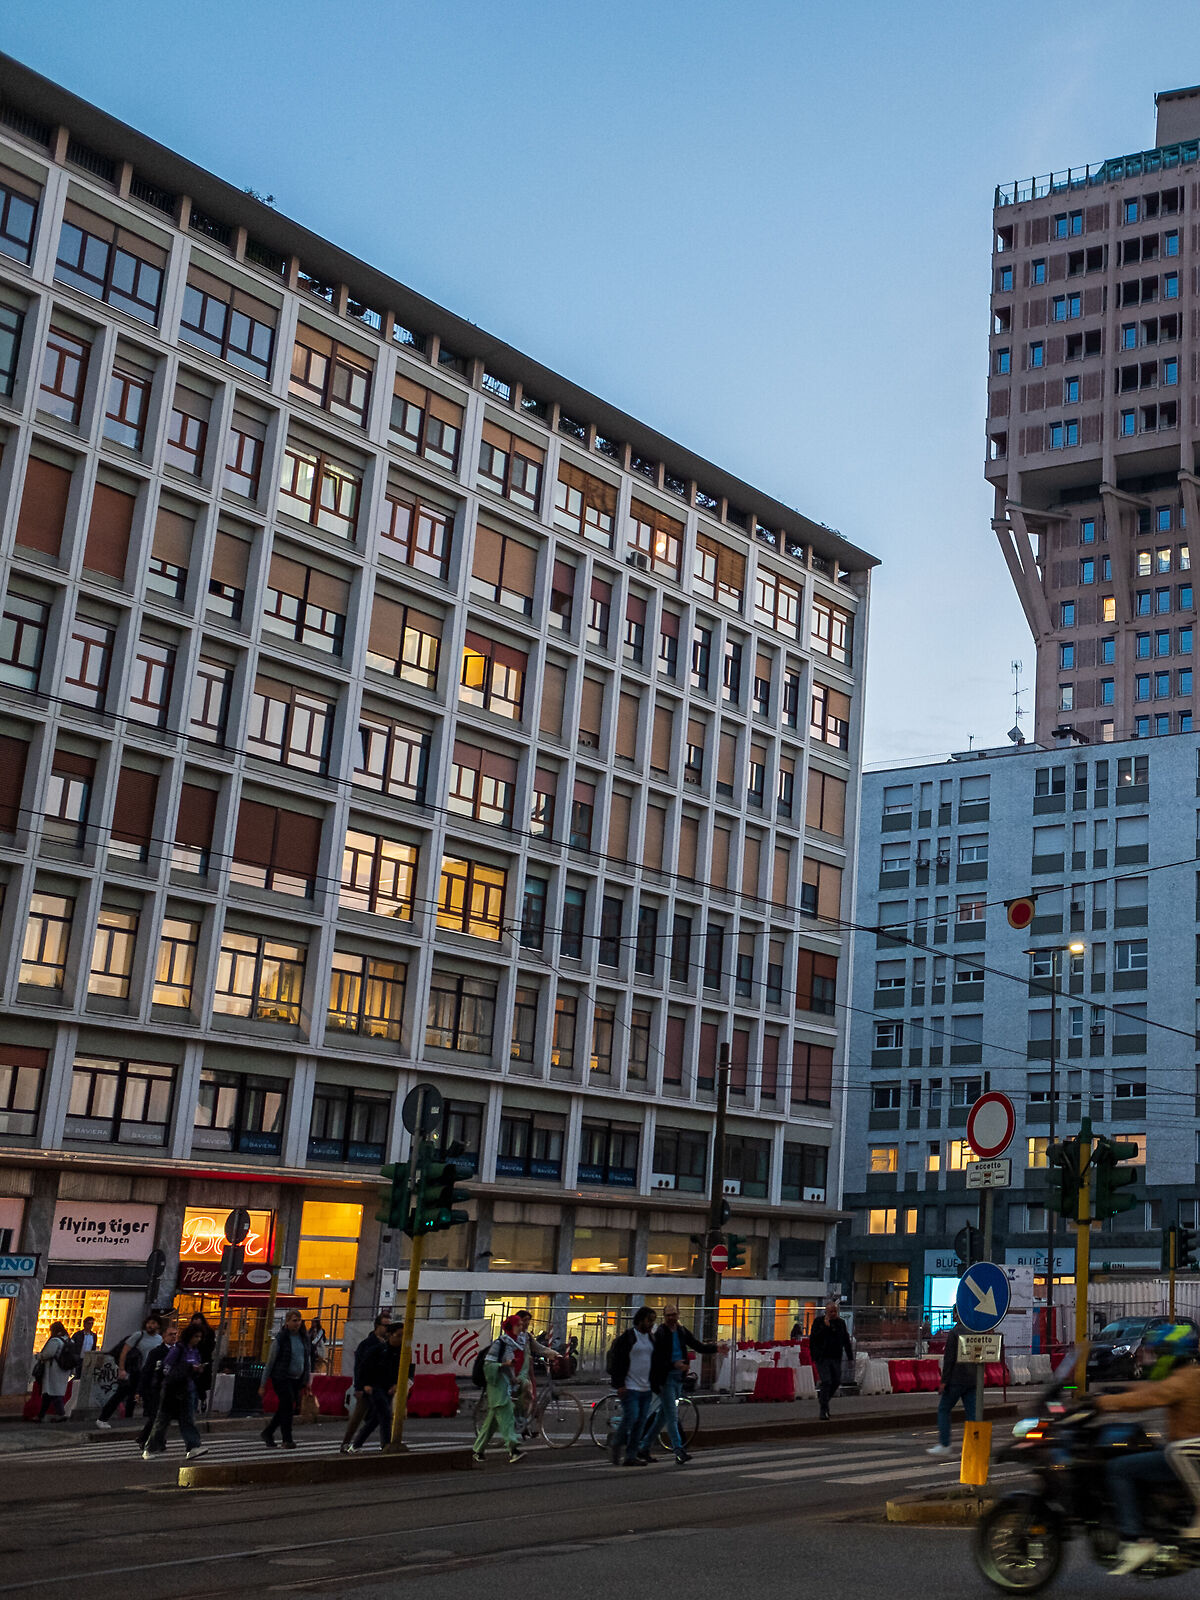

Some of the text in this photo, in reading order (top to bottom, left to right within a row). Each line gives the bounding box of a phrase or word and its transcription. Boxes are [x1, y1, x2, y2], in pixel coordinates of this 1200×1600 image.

[74, 1127, 108, 1136] BAVIERA
[248, 1142, 277, 1150] BAVIERA
[975, 1162, 1001, 1170] eccetto
[59, 1217, 149, 1235] flying tiger
[76, 1235, 129, 1245] copenhagen
[936, 1258, 959, 1268] BLUE
[1018, 1257, 1041, 1266] BLUE
[183, 1267, 218, 1284] Peter
[966, 1336, 992, 1344] eccetto
